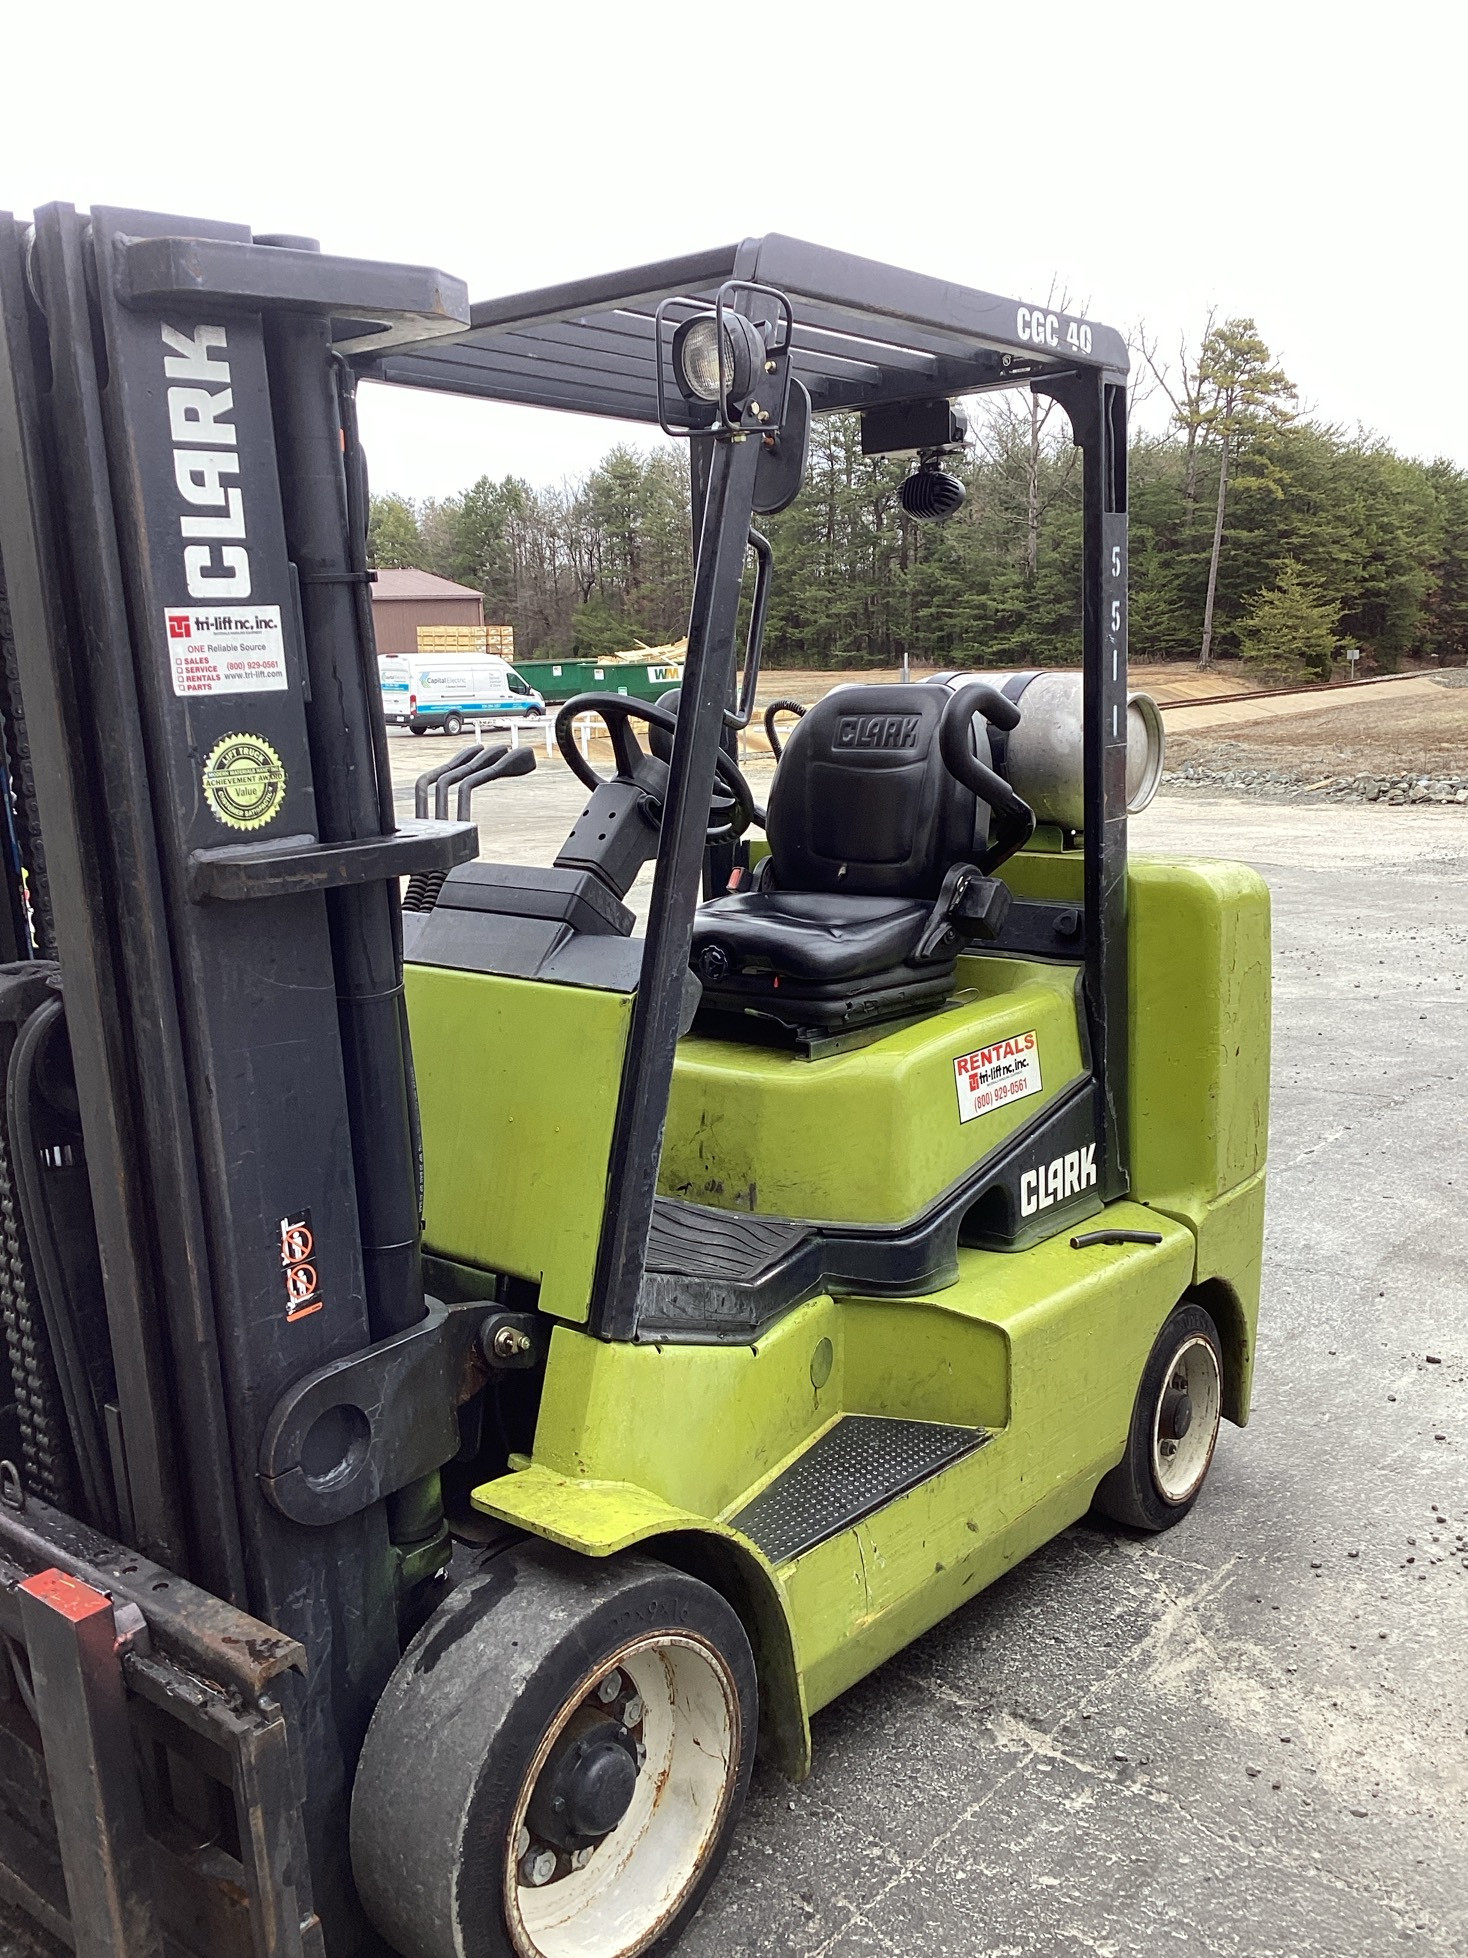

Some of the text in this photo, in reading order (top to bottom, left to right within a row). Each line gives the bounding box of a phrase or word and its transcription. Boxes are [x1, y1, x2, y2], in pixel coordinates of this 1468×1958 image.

[1017, 306, 1092, 355] CGC 40
[160, 320, 252, 598] CLARK
[195, 616, 233, 631] tri-lift
[255, 615, 278, 629] inc.
[187, 643, 267, 653] ONE Reliable Source
[184, 657, 210, 665] SALES
[226, 660, 279, 671] (800) 929-0561
[185, 665, 218, 674] SERVICE
[224, 670, 283, 680] www.tri-lift.com
[654, 667, 679, 680] WM
[186, 674, 221, 683] RENTALS
[427, 677, 446, 685] Capital
[187, 683, 213, 691] PARTS
[837, 717, 920, 748] CLARK
[222, 747, 265, 765] LIFT TRUCK
[205, 773, 284, 787] ACHIEVEMENT AWARD
[235, 786, 258, 797] Value
[957, 1033, 1035, 1077] RENTALS
[979, 1064, 1002, 1085] tri-lift
[1014, 1057, 1030, 1073] inc.
[974, 1092, 993, 1113] (800)
[994, 1077, 1028, 1102] 929-0561
[1020, 1142, 1097, 1218] CLARK
